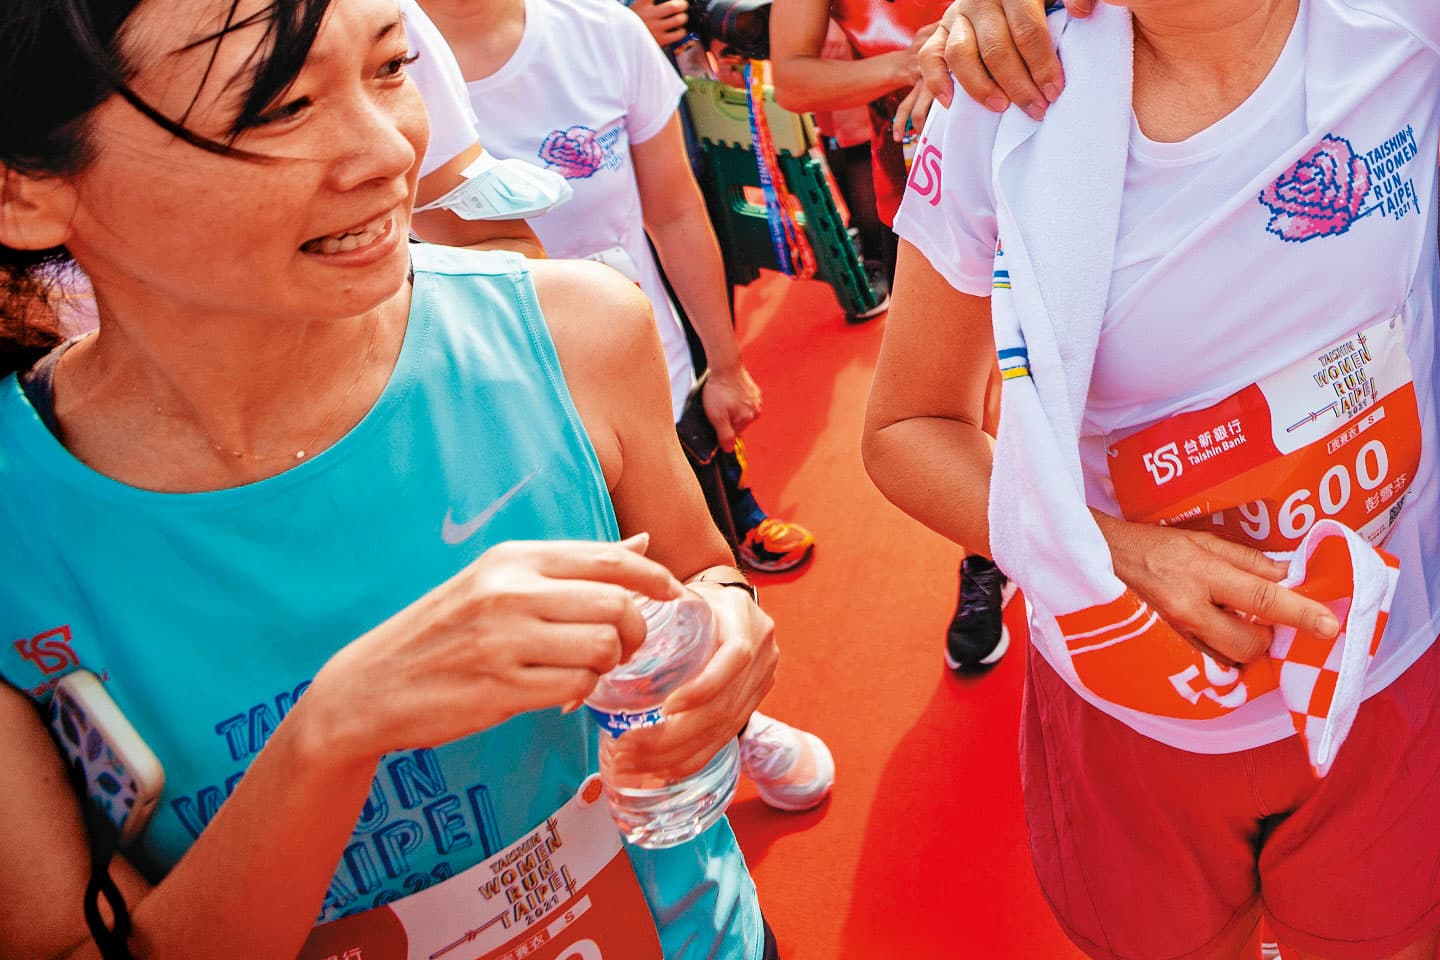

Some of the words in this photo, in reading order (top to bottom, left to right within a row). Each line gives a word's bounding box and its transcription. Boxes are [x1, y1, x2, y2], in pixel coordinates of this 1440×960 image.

[1366, 129, 1408, 166] TAISHIN
[1372, 141, 1418, 181] WOMEN
[1374, 172, 1402, 201] RUN
[1378, 178, 1419, 217] TAIPEI
[1394, 202, 1411, 221] 2021
[1312, 348, 1372, 388] WOMEN
[1318, 341, 1355, 368] TAISHIN
[1332, 376, 1378, 418] TAIPEI
[1333, 367, 1368, 397] RUN
[1183, 419, 1241, 455] 台新銀行
[1187, 445, 1222, 466] Taishin
[1221, 433, 1247, 451] Bank
[478, 835, 563, 901] WOMEN
[489, 832, 542, 875] TAISHIN
[500, 863, 576, 929] TAIPEI
[505, 858, 555, 905] RUN
[524, 894, 560, 926] 2021
[564, 911, 575, 924] S
